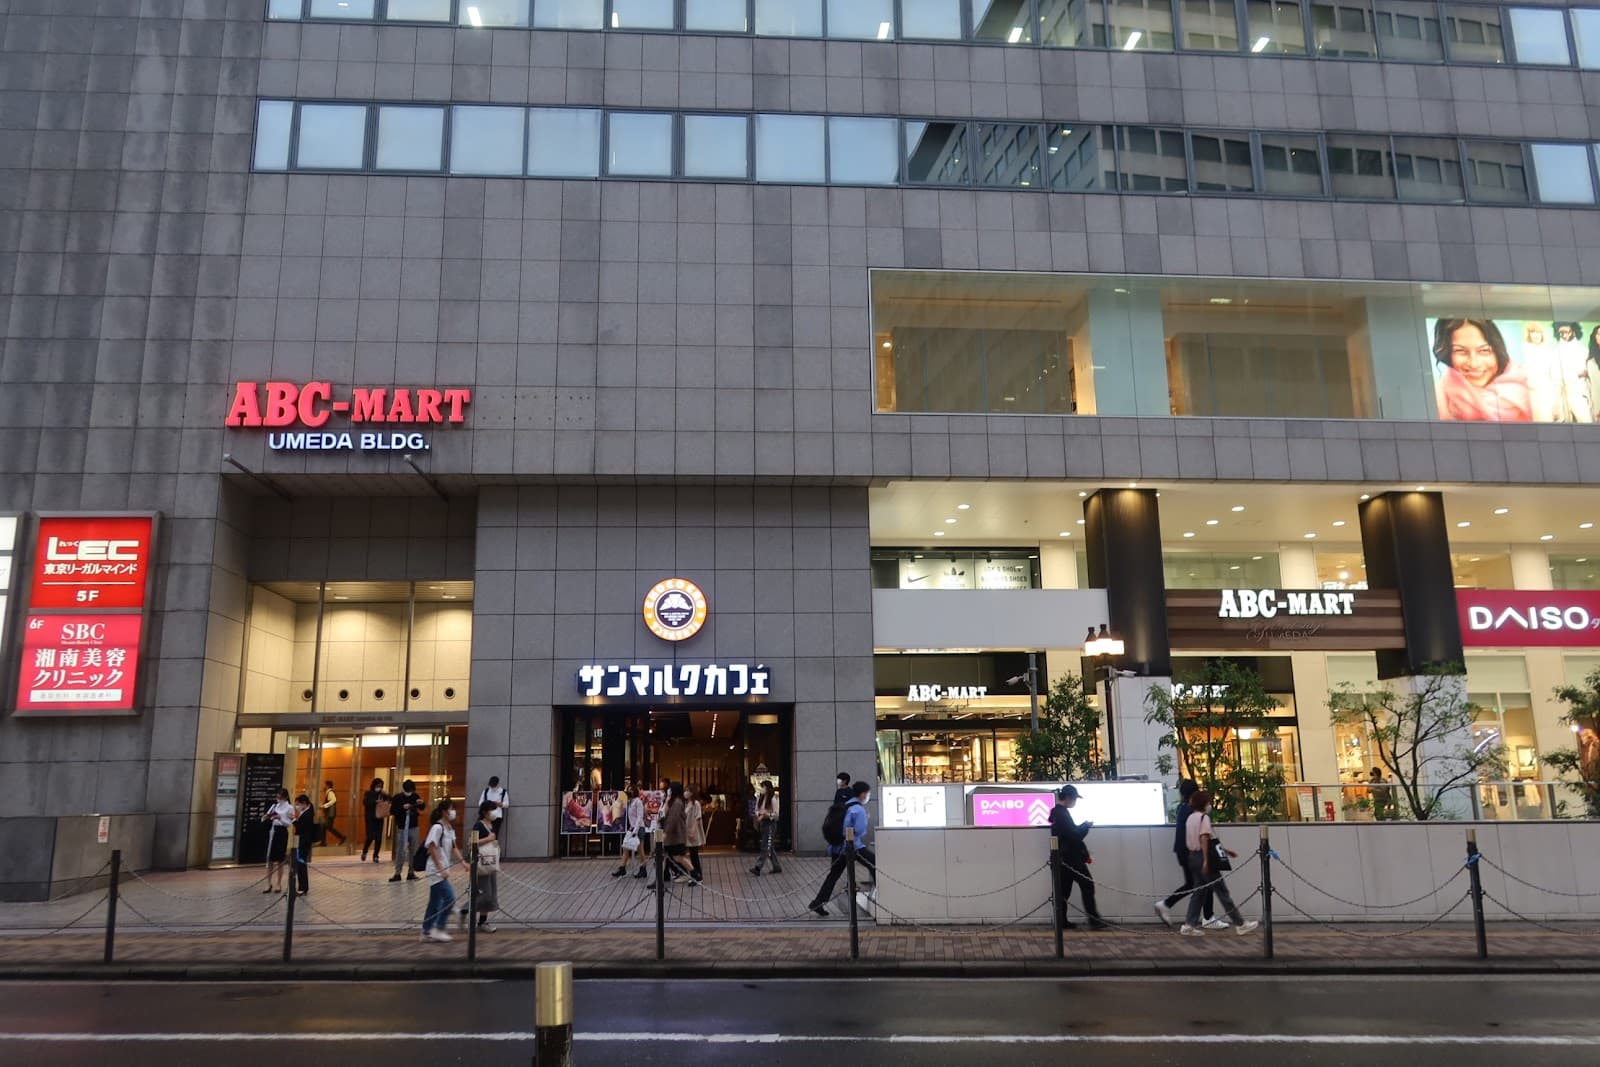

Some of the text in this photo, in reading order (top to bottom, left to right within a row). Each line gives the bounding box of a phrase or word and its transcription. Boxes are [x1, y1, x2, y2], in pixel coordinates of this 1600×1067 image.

[224, 381, 471, 428] ABC-MART
[269, 433, 430, 450] UMEDA BLDG.
[44, 563, 137, 575] 東京リーガルマインド
[76, 590, 99, 602] 5F
[1219, 589, 1355, 618] ABC-MART
[29, 618, 45, 629] 6F
[1468, 606, 1589, 630] DAISO
[61, 623, 105, 640] SBC
[35, 648, 126, 667] 湘南美容
[32, 669, 123, 688] クリニック
[907, 684, 987, 702] ABC-MART
